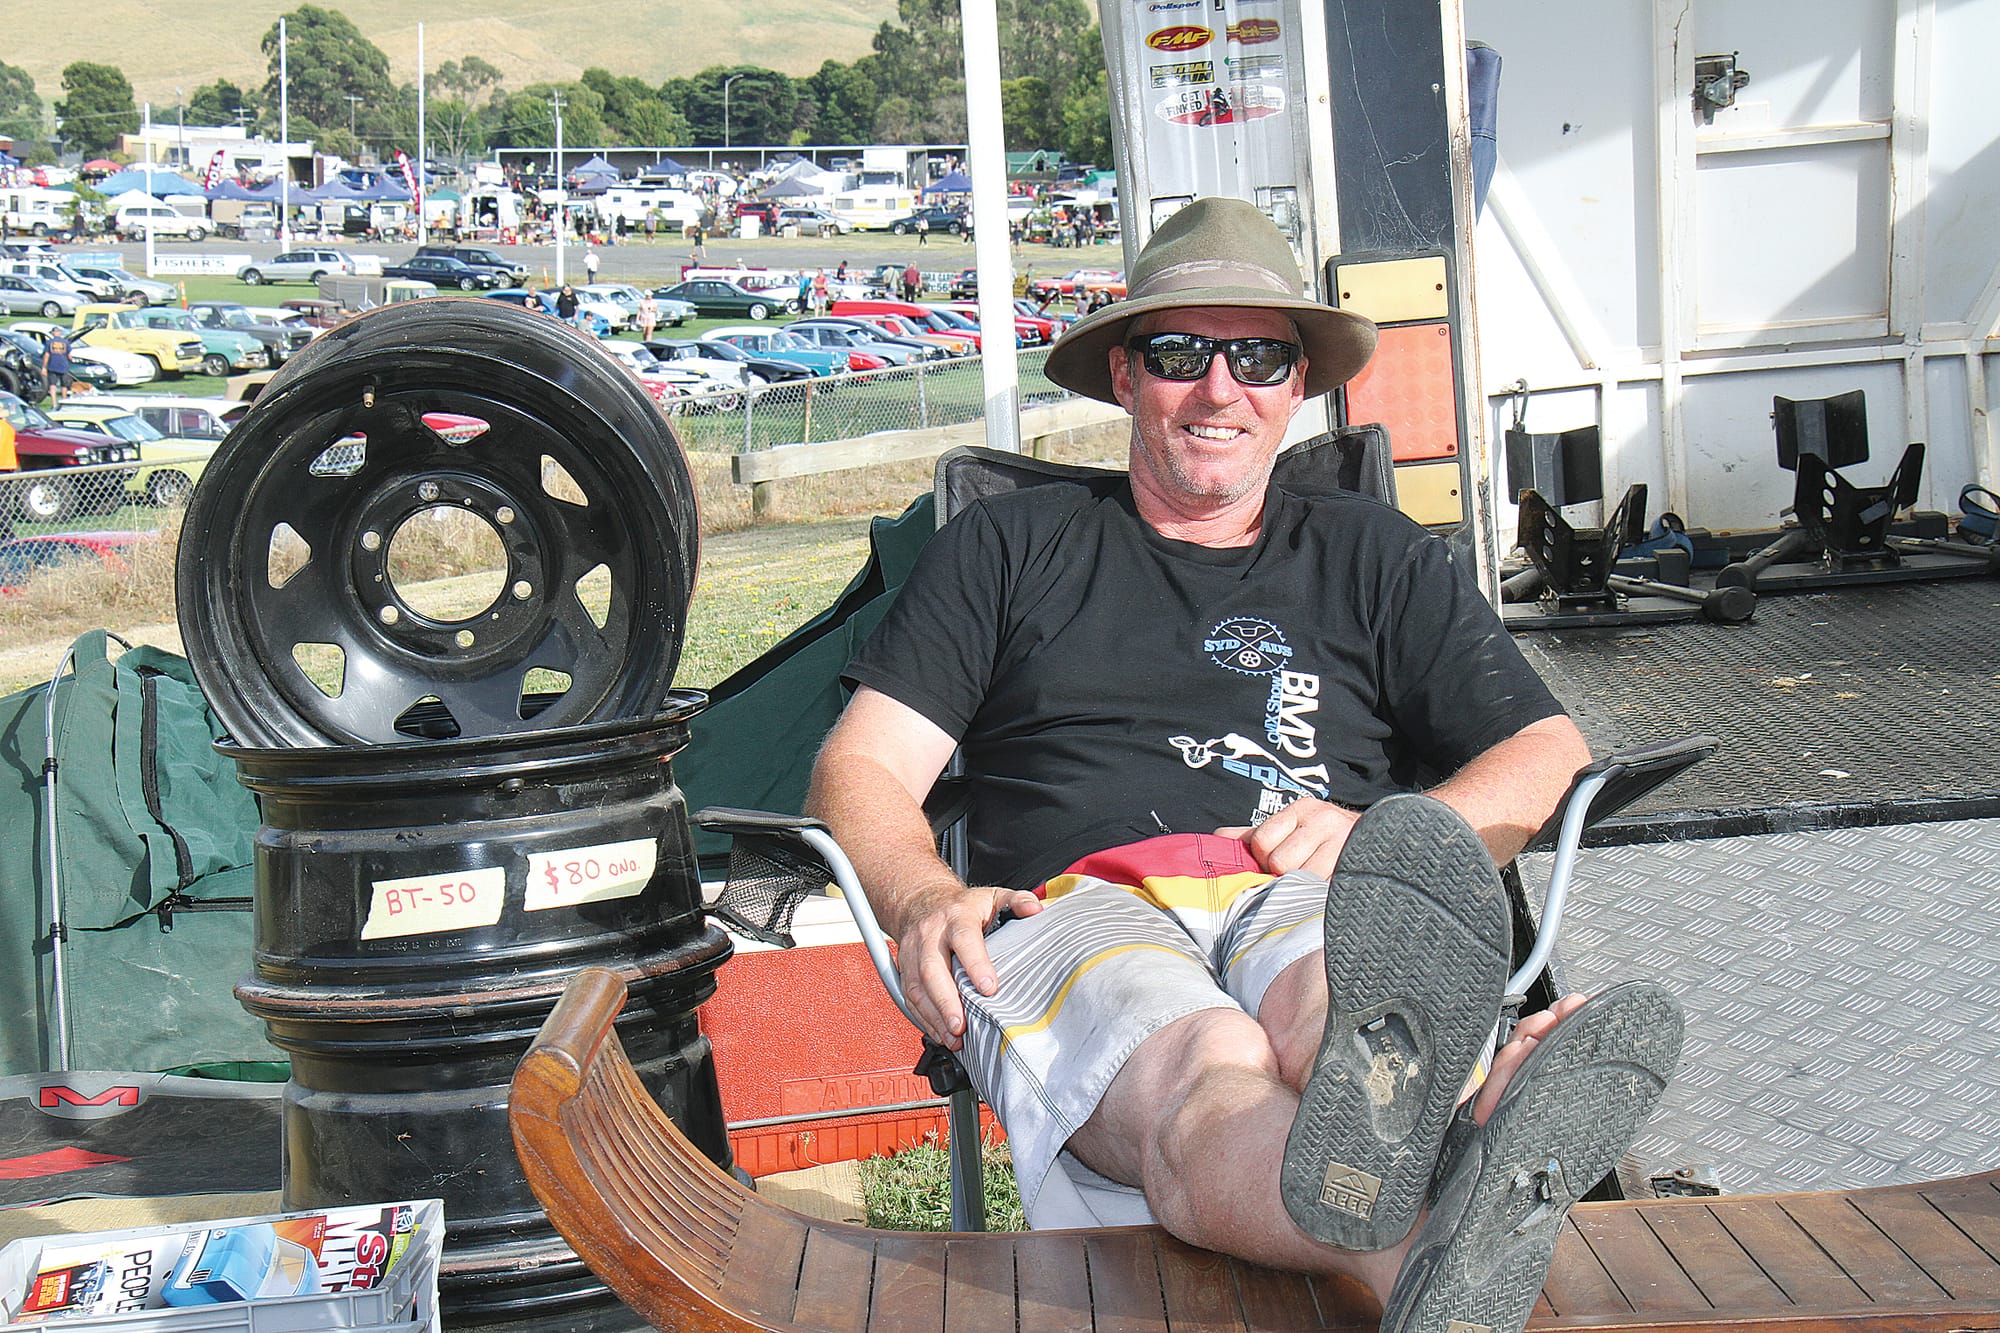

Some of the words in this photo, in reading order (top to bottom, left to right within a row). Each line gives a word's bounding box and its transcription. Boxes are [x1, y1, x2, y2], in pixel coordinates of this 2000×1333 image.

[1151, 31, 1209, 47] FMF
[1181, 91, 1200, 102] GET
[1204, 639, 1241, 652] SYD
[1258, 640, 1293, 658] AUS
[544, 859, 601, 894] $80
[385, 882, 476, 916] BT-50
[819, 1073, 936, 1111] ALPIN
[1323, 1187, 1371, 1218] REEF
[115, 1250, 152, 1315] PEOPLE
